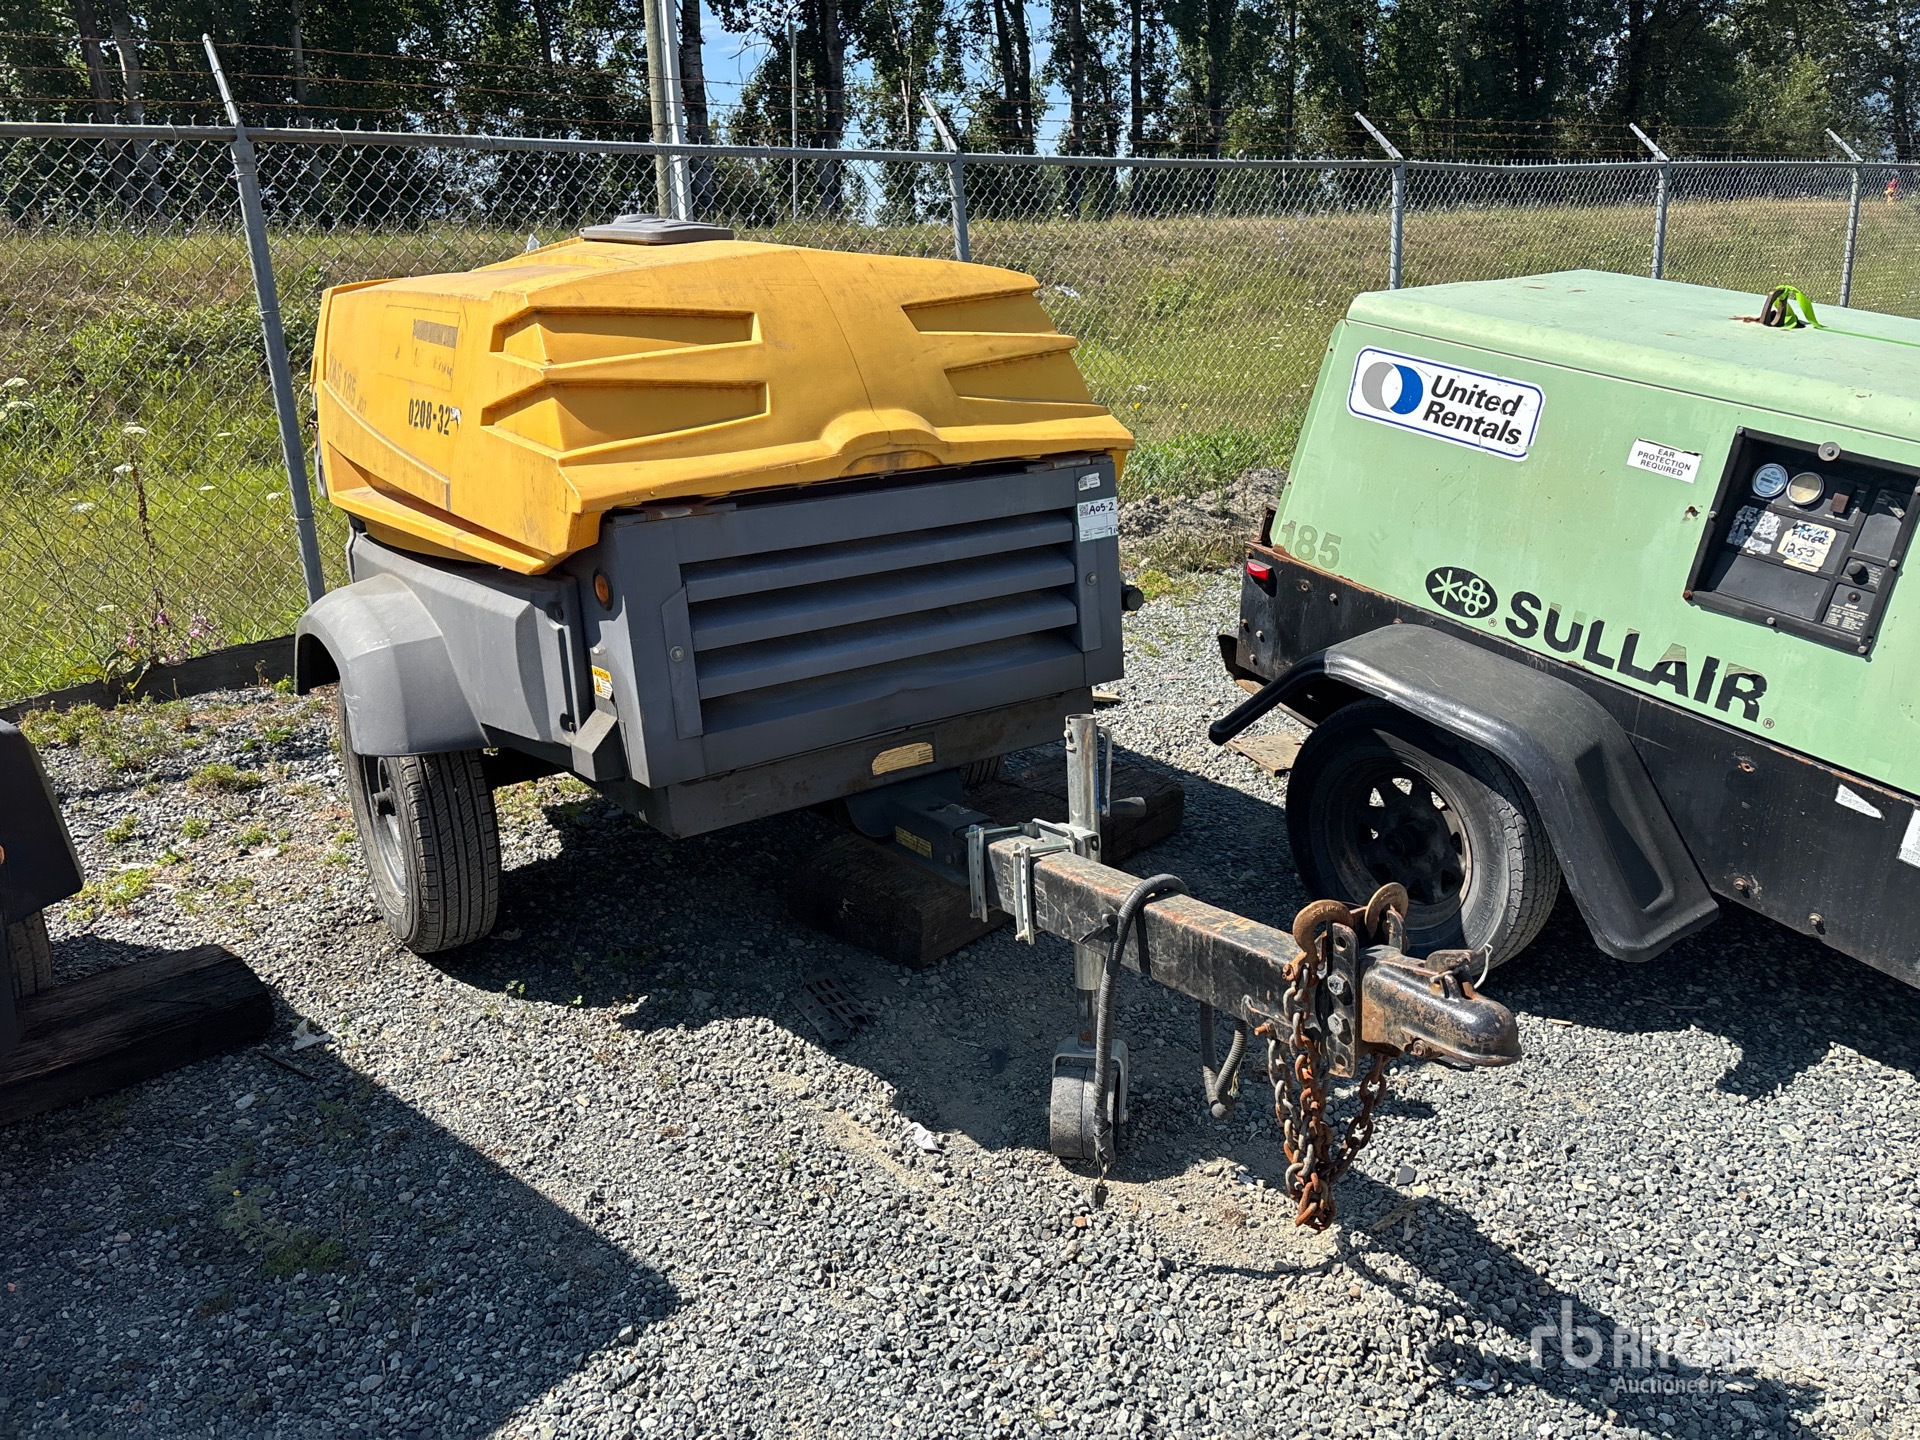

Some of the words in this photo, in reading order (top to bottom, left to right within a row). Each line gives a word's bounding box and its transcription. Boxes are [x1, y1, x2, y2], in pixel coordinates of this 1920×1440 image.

[342, 367, 357, 405] 185
[1431, 375, 1524, 417] United
[1422, 401, 1522, 446] Rentals
[1637, 450, 1692, 471] PROTECTION
[1640, 459, 1684, 477] REQUIRED
[1657, 448, 1676, 459] EAR
[1279, 519, 1342, 569] 185
[1504, 590, 1768, 723] SULLAIR
